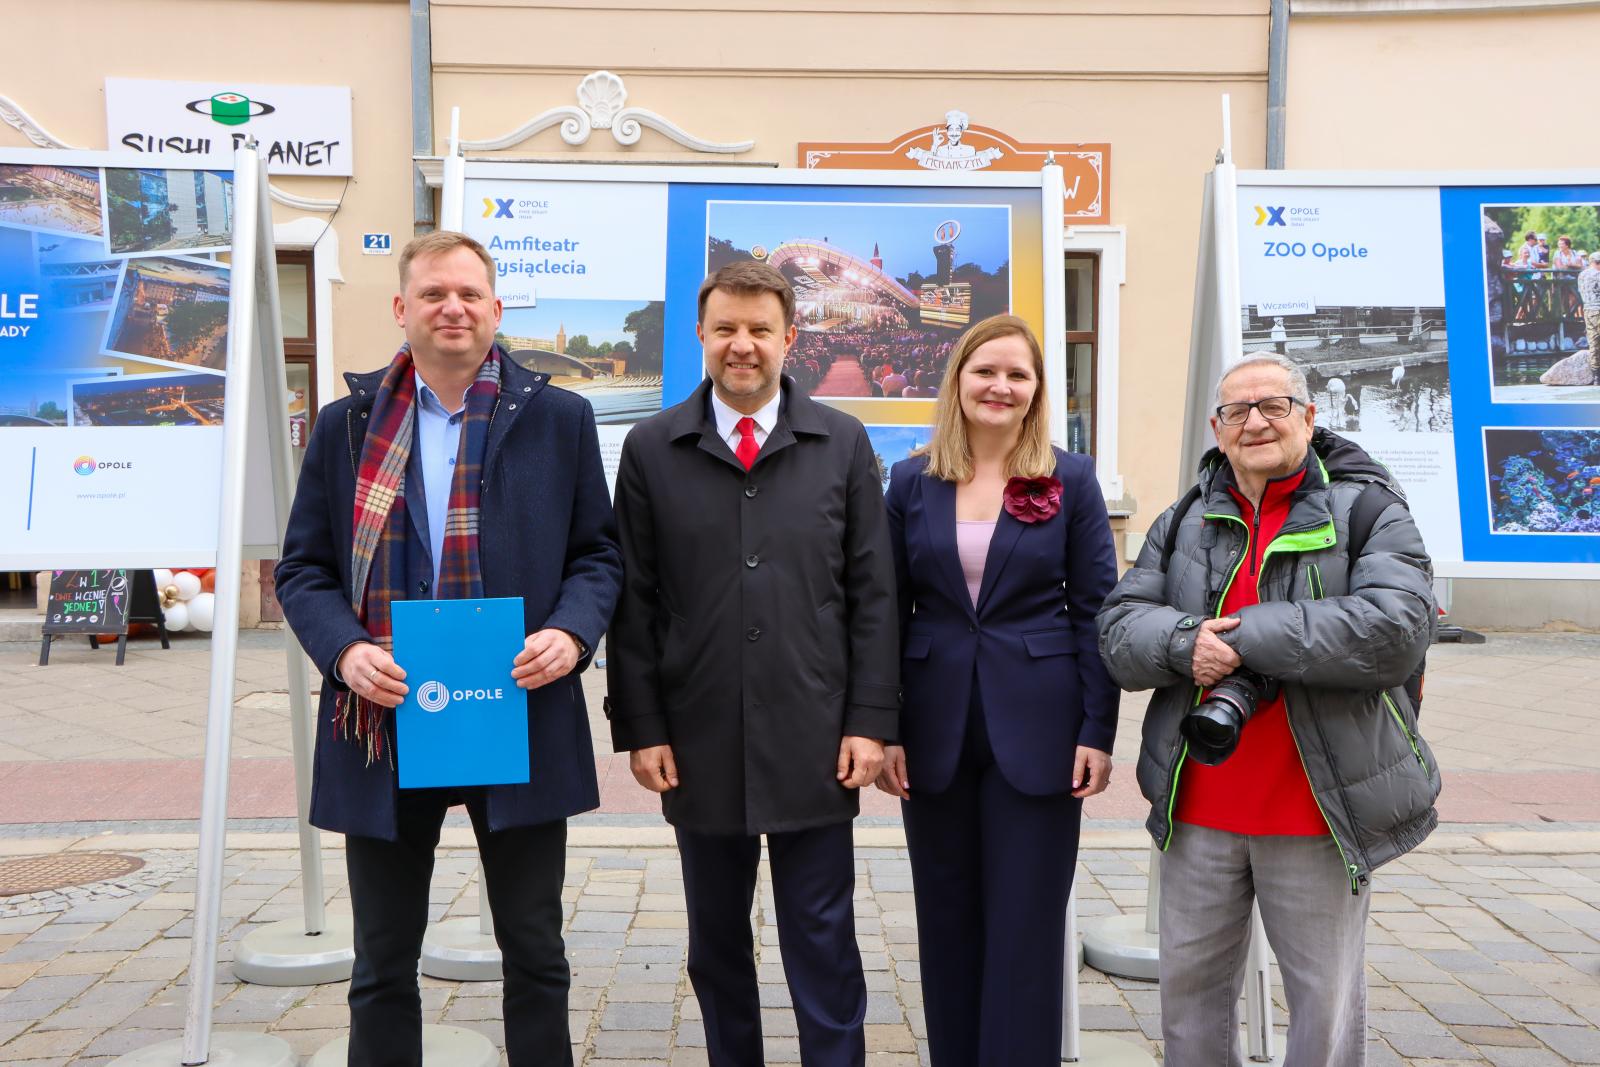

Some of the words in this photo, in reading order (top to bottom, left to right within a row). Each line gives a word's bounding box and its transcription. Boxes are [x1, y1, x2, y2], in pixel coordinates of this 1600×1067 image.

[519, 200, 549, 208] OPOLE
[1290, 207, 1320, 216] OPOLE
[369, 235, 386, 248] 21
[489, 235, 580, 253] Amfiteatr
[1264, 242, 1306, 257] ZOO
[1312, 242, 1369, 262] Opole
[1262, 300, 1310, 311] Wcześniej
[98, 461, 133, 470] OPOLE
[83, 589, 107, 601] CENIE
[452, 688, 504, 701] OPOLE
